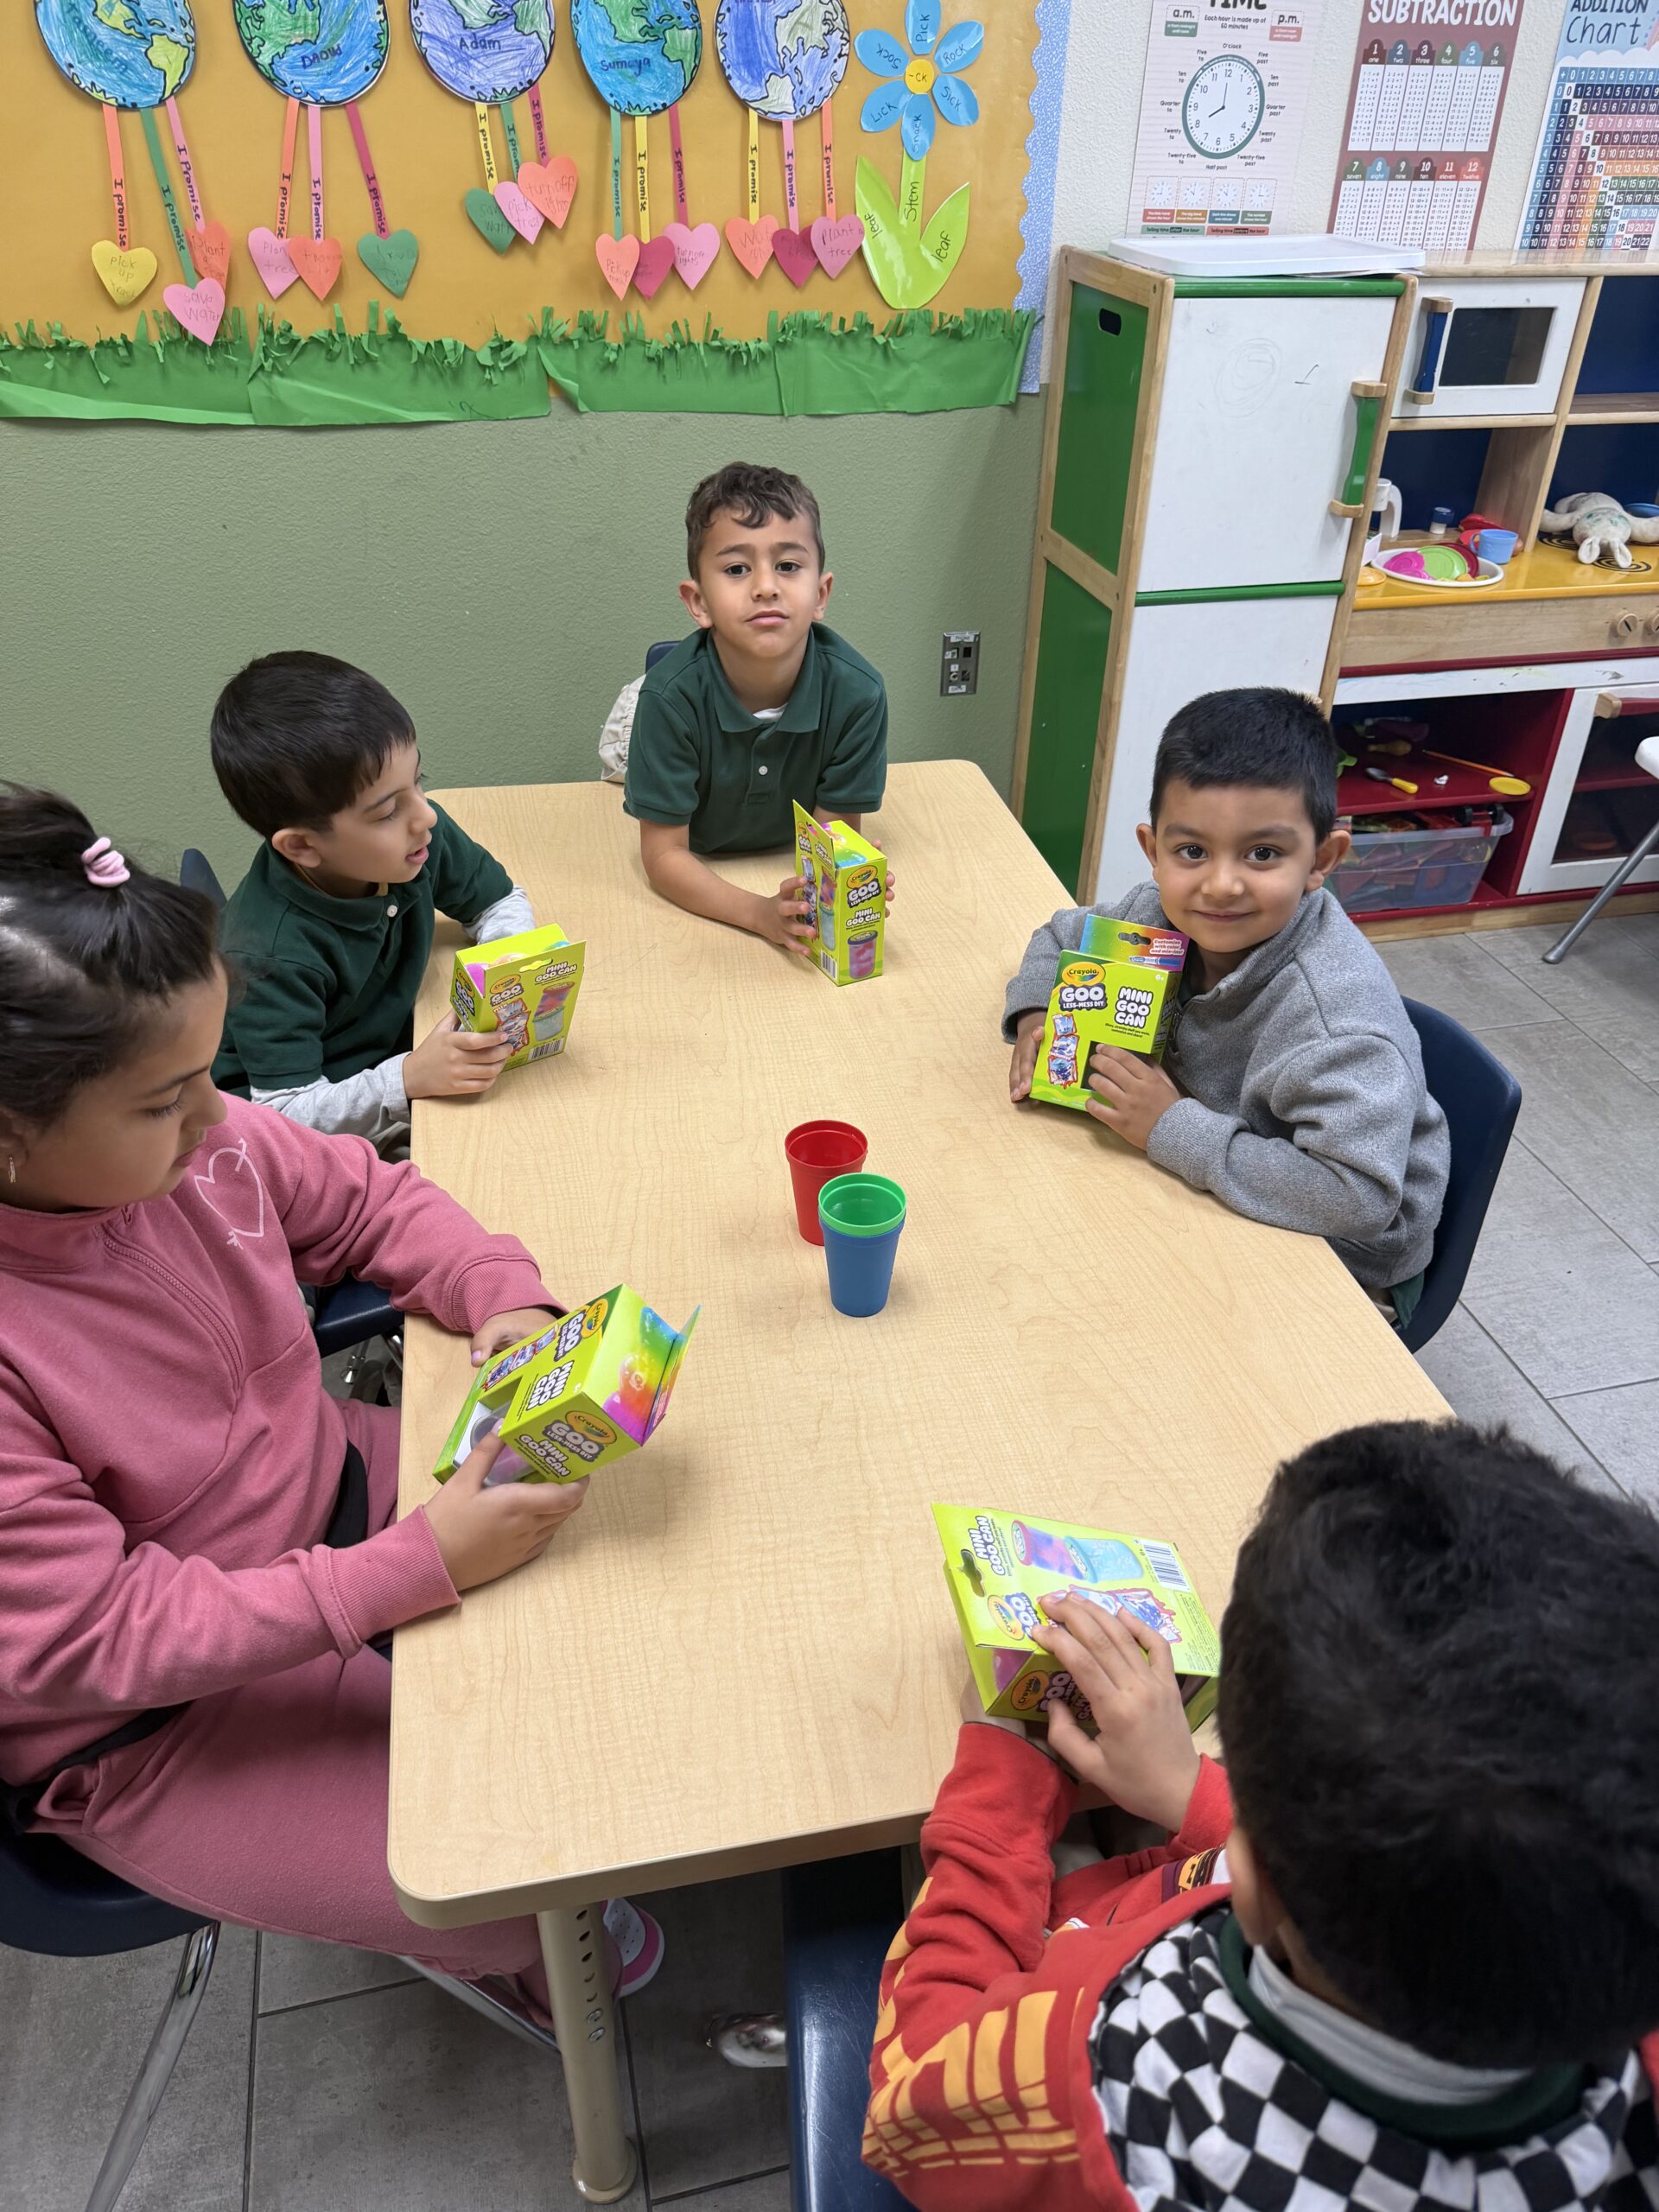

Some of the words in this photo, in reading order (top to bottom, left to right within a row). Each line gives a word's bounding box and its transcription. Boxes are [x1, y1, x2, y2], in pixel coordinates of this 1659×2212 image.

[1173, 9, 1195, 18] a.m.
[1368, 0, 1518, 26] SUBTRACTION
[1571, 0, 1649, 13] ADDITION
[1278, 15, 1300, 25] p.m.
[1567, 16, 1641, 45] Chart
[459, 34, 501, 50] Adam
[1373, 44, 1377, 54] 1
[1395, 44, 1403, 55] 2
[1421, 45, 1427, 55] 3
[1446, 45, 1452, 55] 4
[1469, 46, 1475, 56] 5
[1493, 46, 1499, 56] 6
[601, 56, 651, 76] Sumaya
[532, 100, 540, 110] I
[479, 113, 486, 124] I
[1195, 119, 1200, 128] 8
[507, 124, 515, 134] I
[177, 145, 188, 156] I
[480, 129, 493, 180] promise
[674, 148, 683, 158] I
[751, 145, 758, 154] I
[786, 149, 794, 159] I
[824, 143, 832, 152] I
[613, 156, 620, 165] I
[638, 151, 646, 161] I
[1352, 162, 1359, 172] 7
[1376, 162, 1382, 172] 8
[1400, 162, 1406, 172] 9
[1421, 162, 1431, 172] 10
[1445, 162, 1453, 172] 11
[1468, 162, 1478, 172] 12
[114, 179, 124, 189] I
[282, 173, 291, 181] I
[313, 179, 321, 188] I
[366, 173, 376, 184] I
[749, 159, 758, 203] promise
[162, 185, 171, 196] I
[637, 167, 647, 212] promise
[785, 163, 795, 207] promise
[905, 181, 919, 222] Stem
[276, 187, 288, 238] promise
[311, 192, 324, 239] promise
[113, 194, 126, 247] promise
[165, 202, 186, 251] promise
[863, 212, 883, 239] leaf
[931, 229, 951, 264] leaf
[849, 881, 878, 901] GOO
[847, 918, 864, 926] GOO
[865, 912, 880, 922] CAN
[855, 908, 873, 918] MINI
[535, 971, 557, 982] GOO
[558, 964, 577, 975] CAN
[546, 962, 568, 973] MINI
[492, 985, 522, 1003] GOO
[1061, 987, 1103, 1002] GOO
[1119, 988, 1153, 1005] MINI
[1116, 1001, 1149, 1015] GOO
[1116, 1012, 1146, 1027] CAN
[564, 1313, 584, 1351] GOO
[539, 1368, 560, 1405] GOO
[551, 1361, 575, 1398] MINI
[526, 1376, 548, 1411] CAN
[547, 1431, 581, 1452] LESS-MESS
[552, 1422, 599, 1454] GOO
[520, 1435, 547, 1456] GOO
[544, 1456, 570, 1476] CAN
[539, 1440, 568, 1462] MINI
[976, 1516, 995, 1543] CAN
[969, 1529, 988, 1559] MINI
[986, 1544, 1005, 1575] GOO
